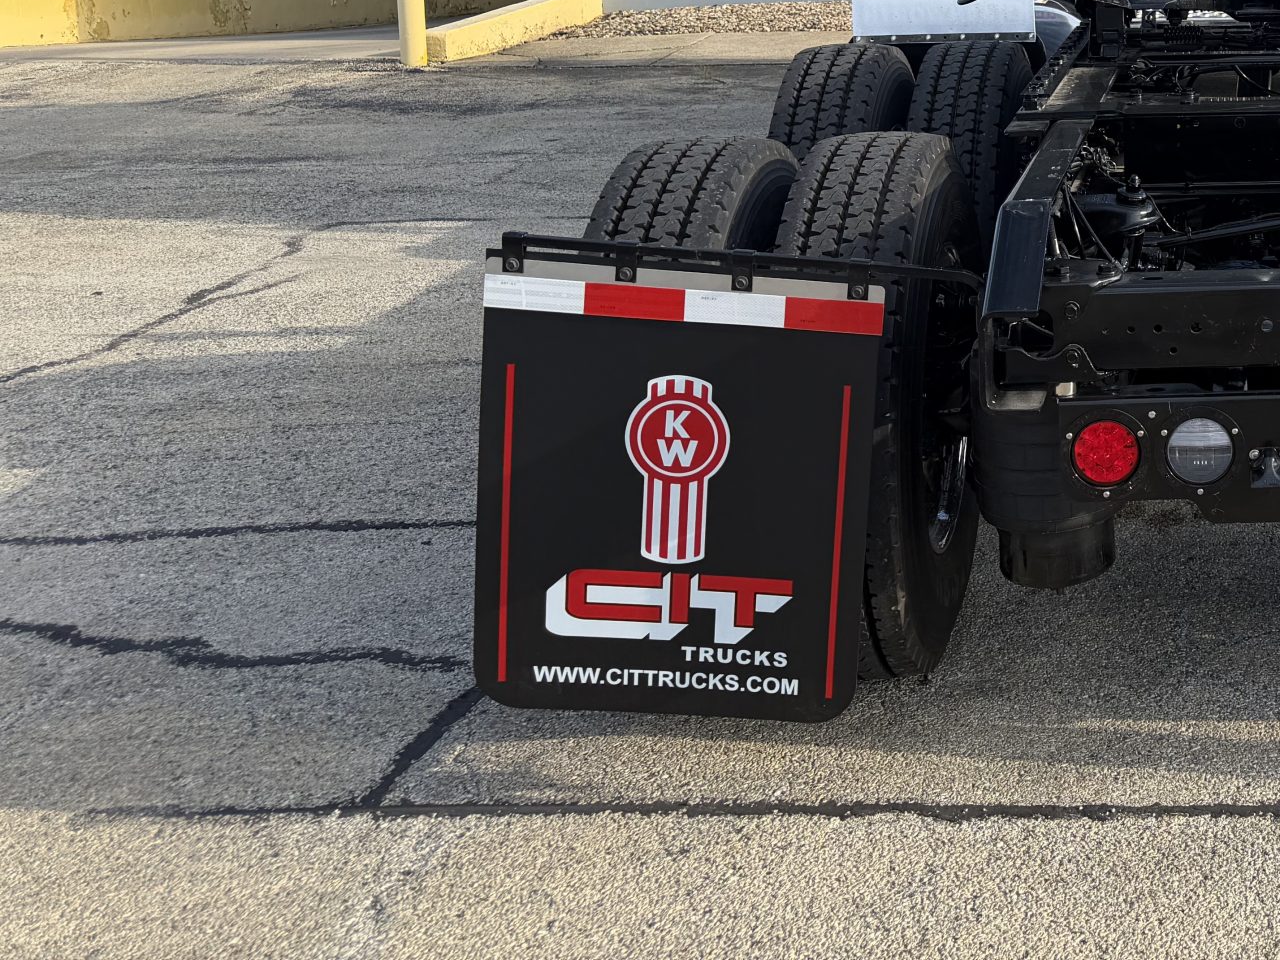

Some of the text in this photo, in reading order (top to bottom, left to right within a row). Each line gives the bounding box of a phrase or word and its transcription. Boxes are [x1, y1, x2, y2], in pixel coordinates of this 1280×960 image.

[545, 569, 793, 645] CIT
[681, 646, 788, 667] TRUCKS
[533, 666, 799, 696] WWW.CITTRUCKS.COM
